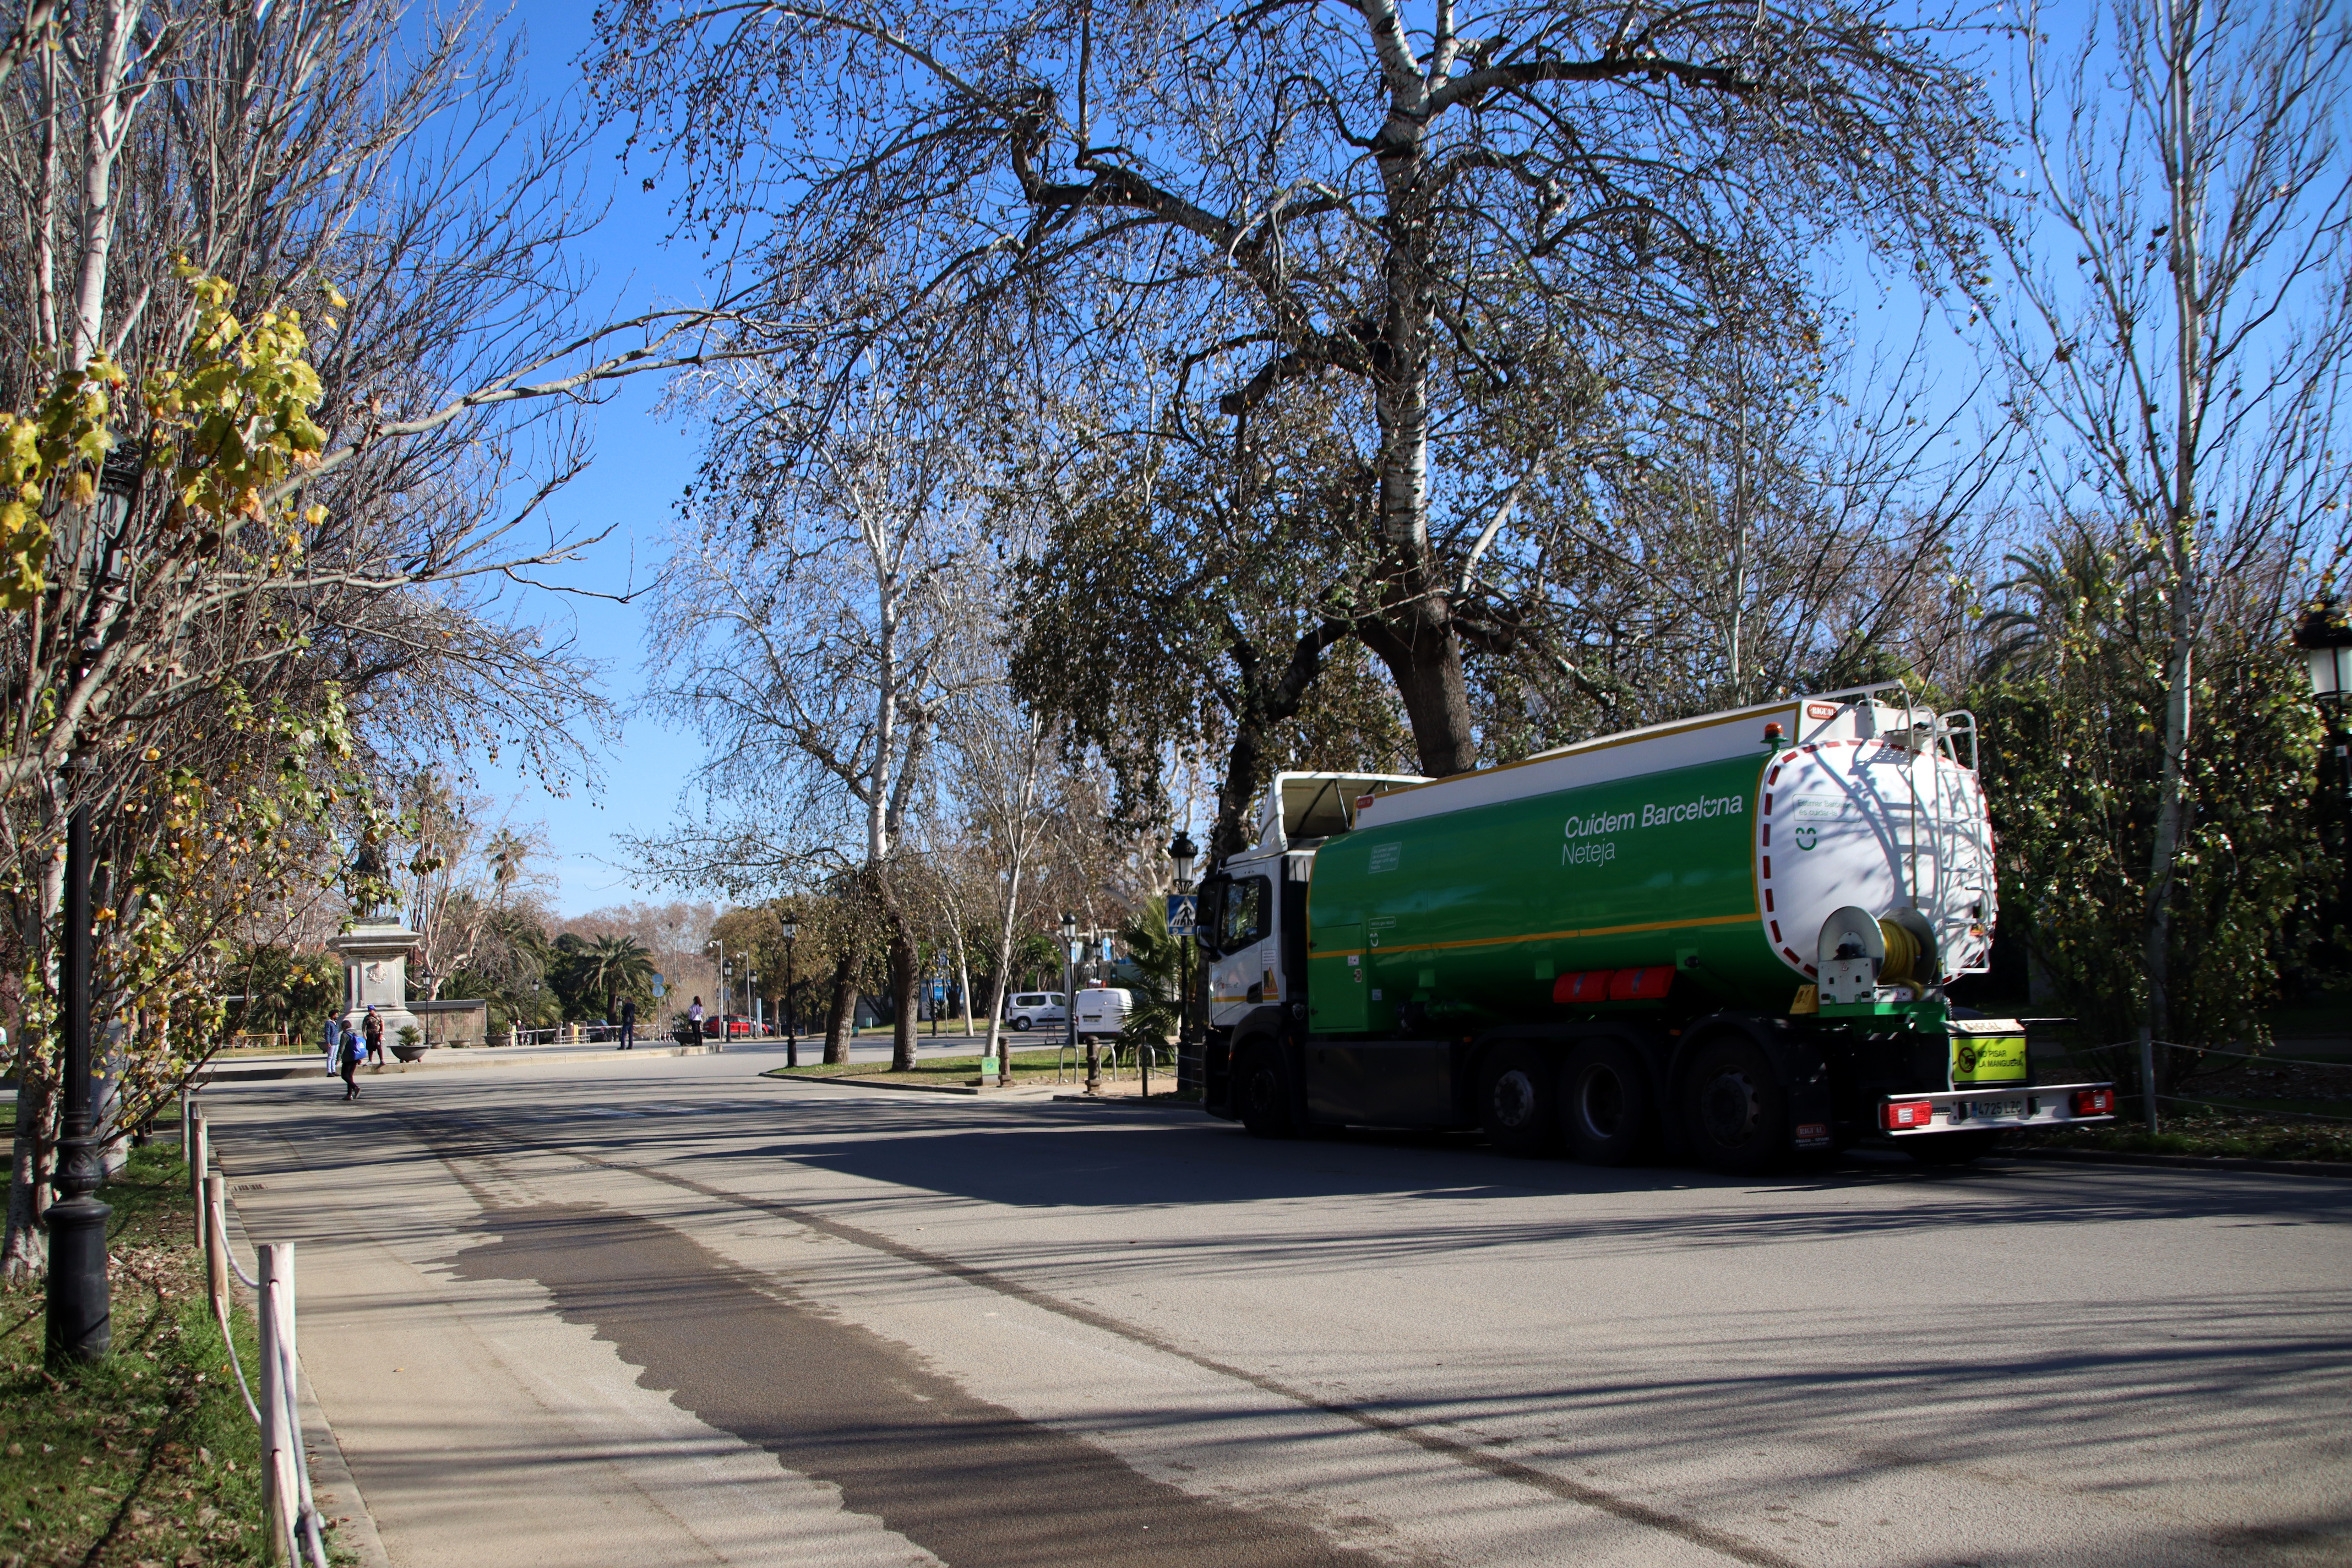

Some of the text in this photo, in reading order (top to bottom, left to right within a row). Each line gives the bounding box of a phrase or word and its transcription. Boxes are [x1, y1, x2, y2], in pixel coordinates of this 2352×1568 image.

[1798, 799, 1822, 807] Estimar
[1565, 794, 1743, 838] Cuidem Barcelona
[1562, 838, 1615, 867] Neteja
[1988, 1059, 2023, 1067] MANGUERA
[1978, 1101, 2022, 1115] 4725 LZC
